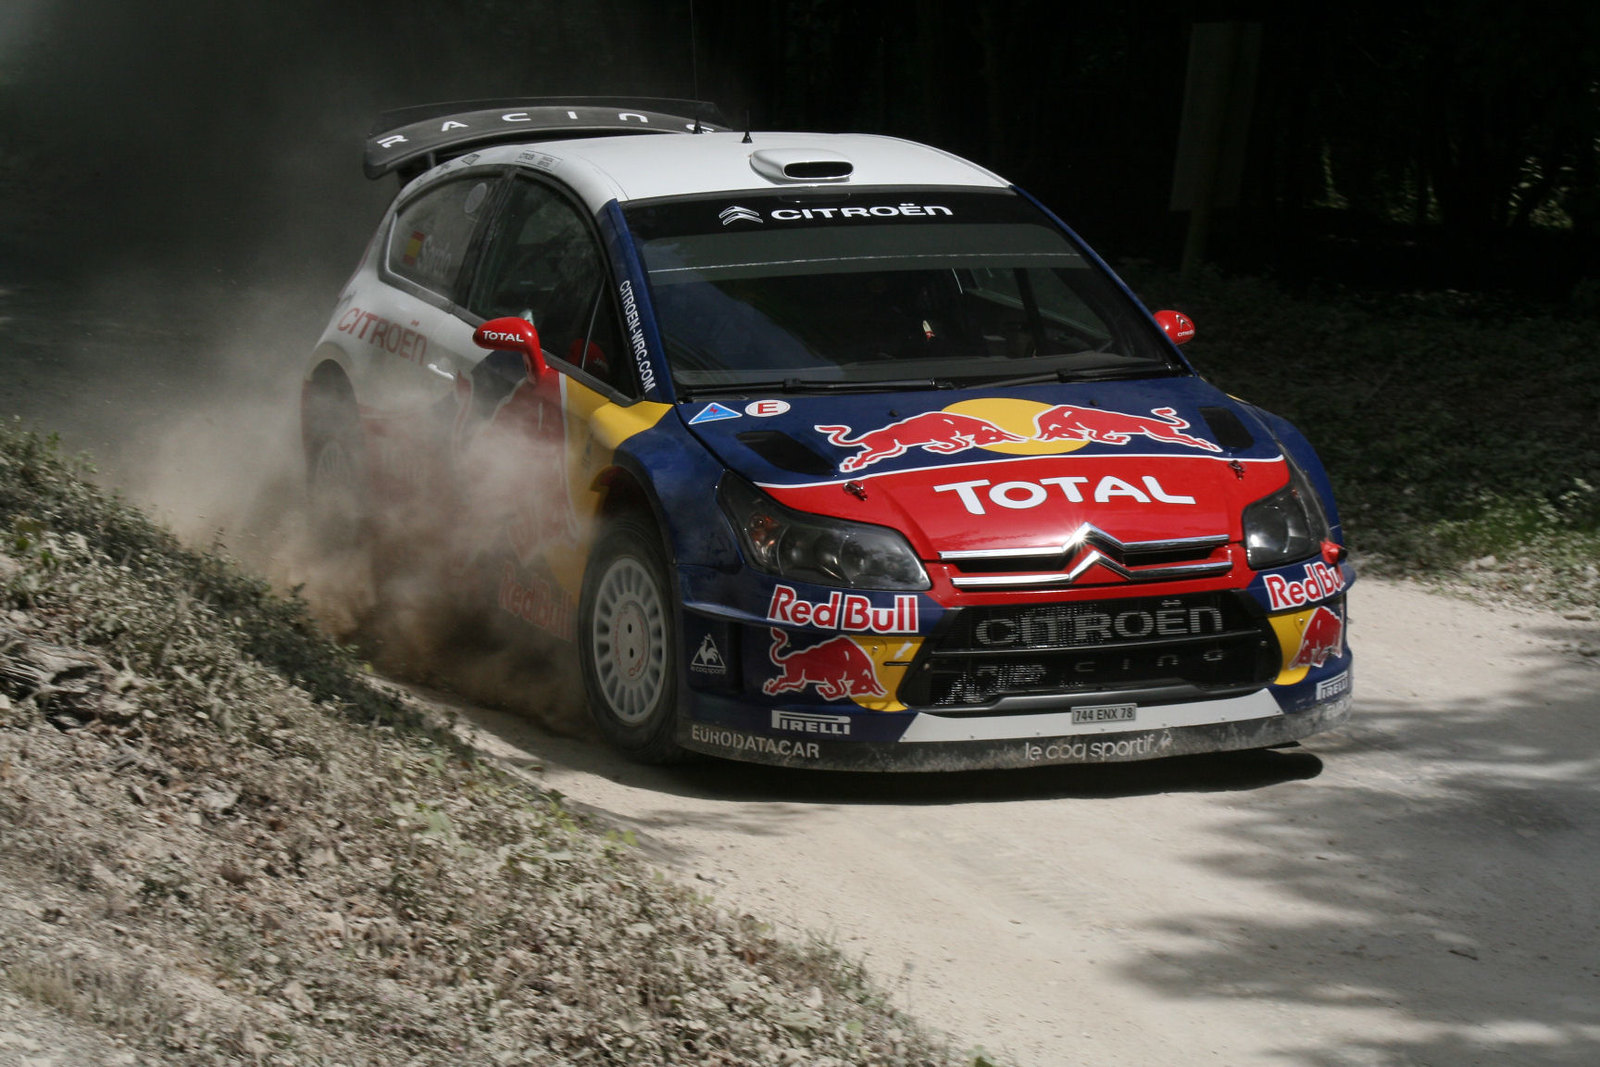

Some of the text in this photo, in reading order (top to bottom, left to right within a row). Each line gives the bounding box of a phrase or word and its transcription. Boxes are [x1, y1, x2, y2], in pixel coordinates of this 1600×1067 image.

[771, 203, 953, 220] CITROËN
[482, 330, 525, 343] TOTAL
[619, 280, 656, 393] CITROEN-WRC.COM
[757, 402, 779, 415] E
[933, 475, 1196, 516] TOTAL
[1263, 564, 1323, 611] Red
[767, 584, 919, 634] Red Bull
[976, 600, 1223, 645] CITROËN
[771, 709, 851, 735] PIRELLI
[1076, 708, 1133, 721] 744 ENX 78
[691, 724, 820, 759] EURODATACAR
[1025, 733, 1155, 761] le coq sportif
